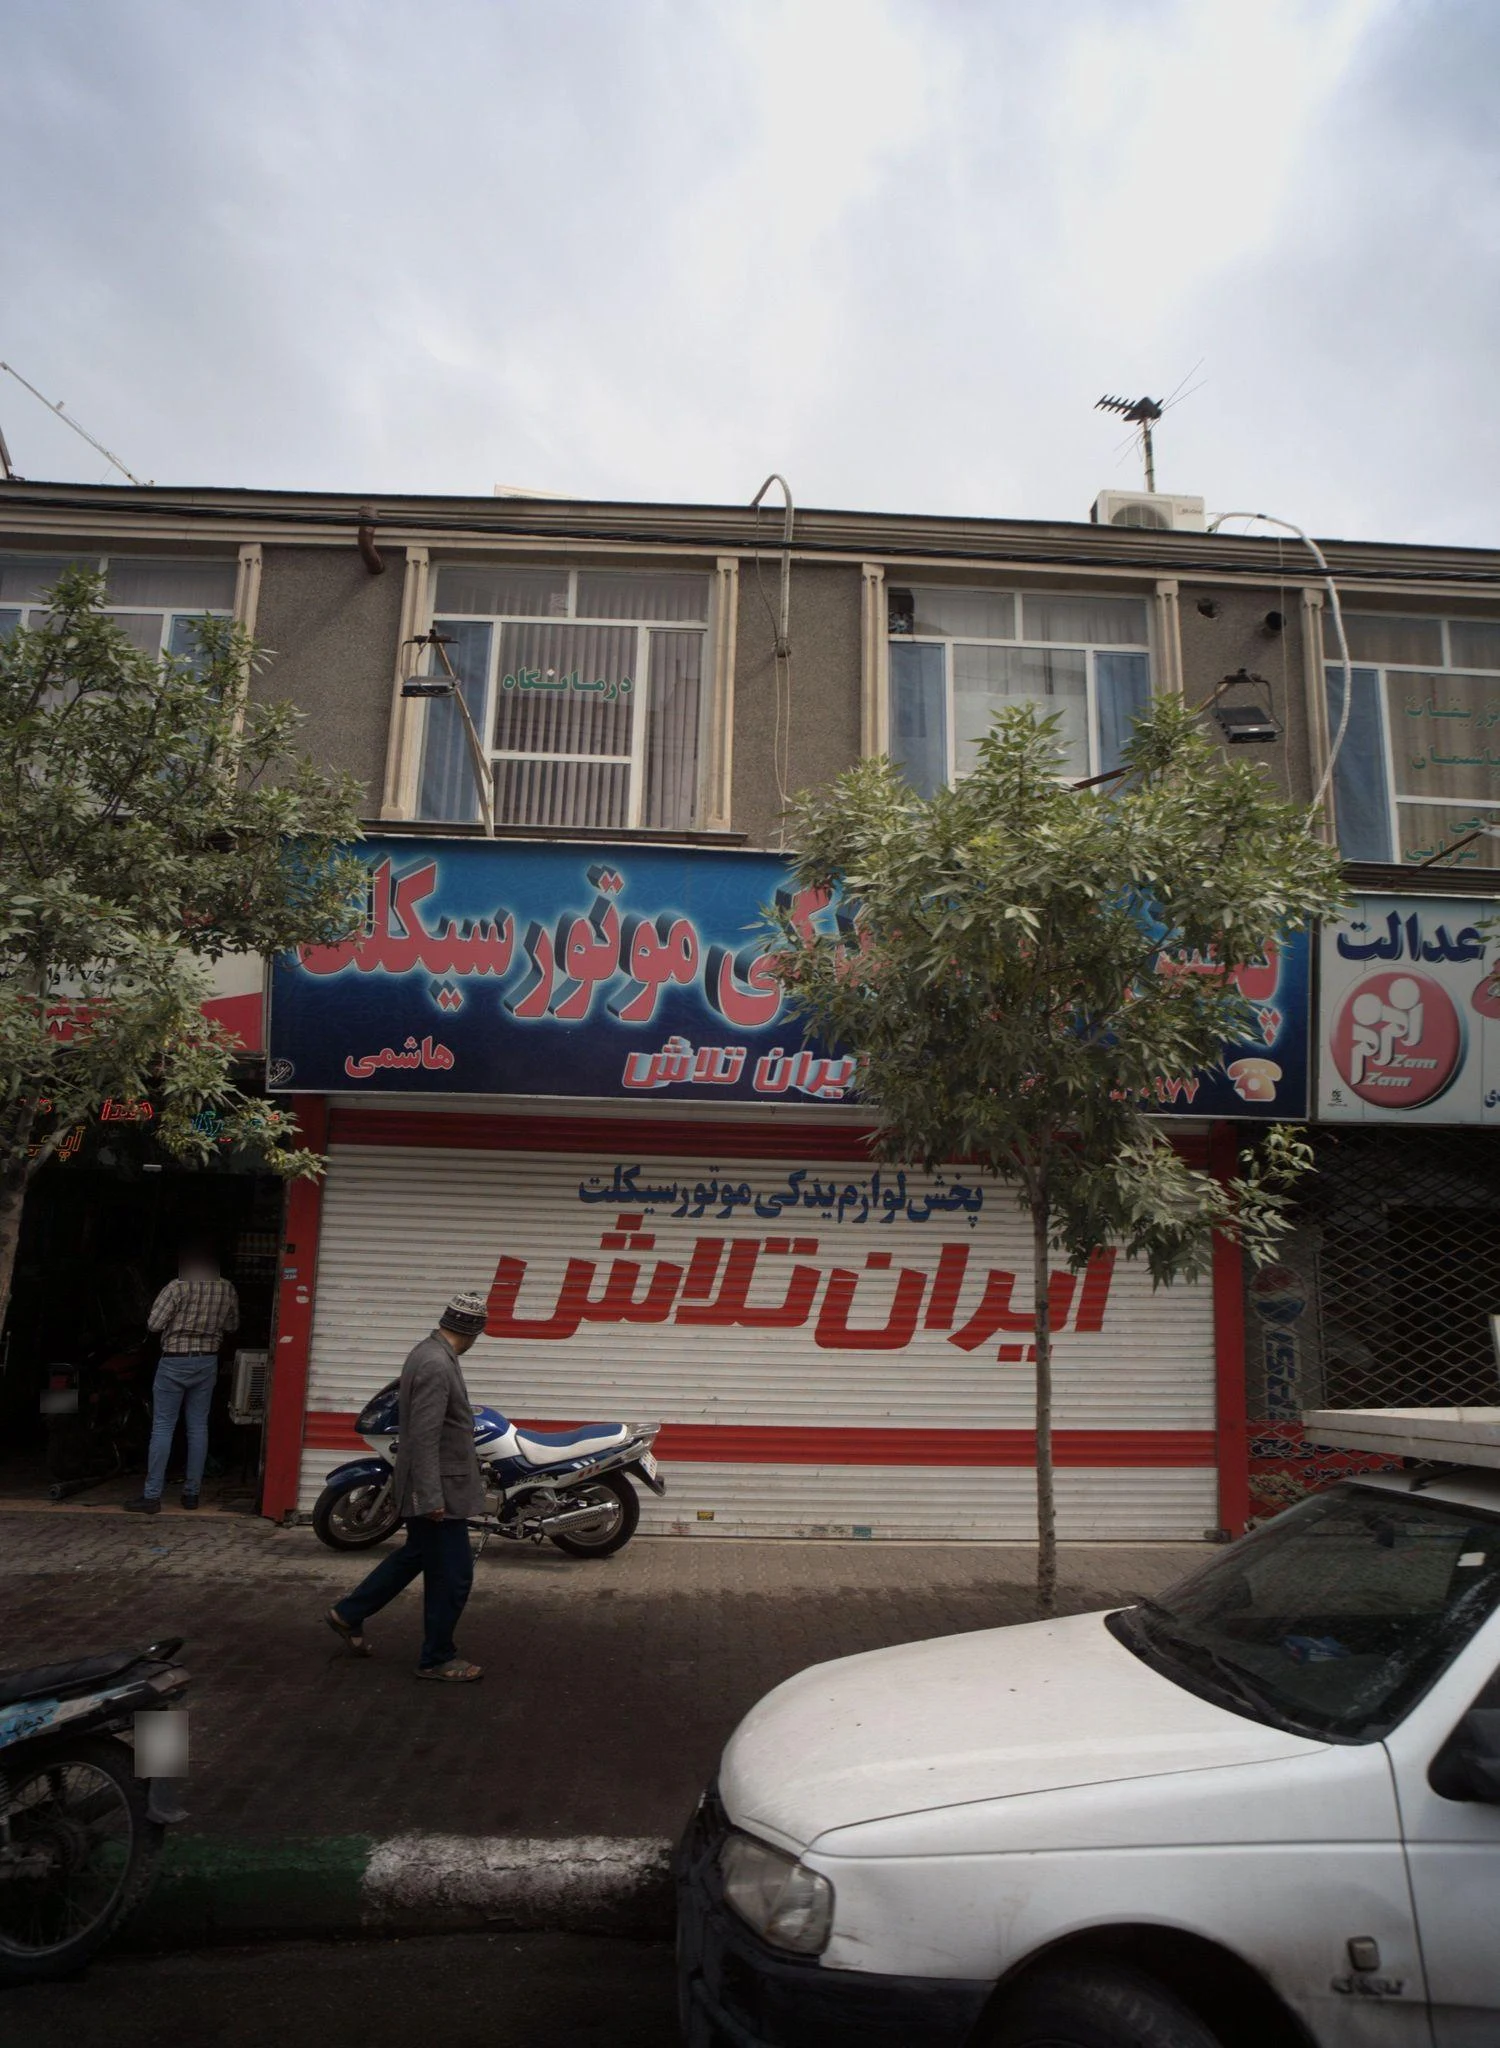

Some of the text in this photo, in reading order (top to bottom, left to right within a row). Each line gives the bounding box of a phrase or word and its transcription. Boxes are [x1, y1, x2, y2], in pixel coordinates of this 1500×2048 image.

[503, 666, 633, 699] درمانگاه
[1337, 911, 1486, 962] عدالت
[344, 1035, 456, 1078] هاشمی
[621, 1036, 871, 1099] یران تلاش
[1364, 1072, 1412, 1087] Zam
[1391, 1054, 1438, 1069] Zam
[754, 1168, 836, 1219] یدکی
[838, 1169, 907, 1224] لوازم
[907, 1172, 983, 1229] پخش
[484, 1213, 1117, 1363] ایران تلاش
